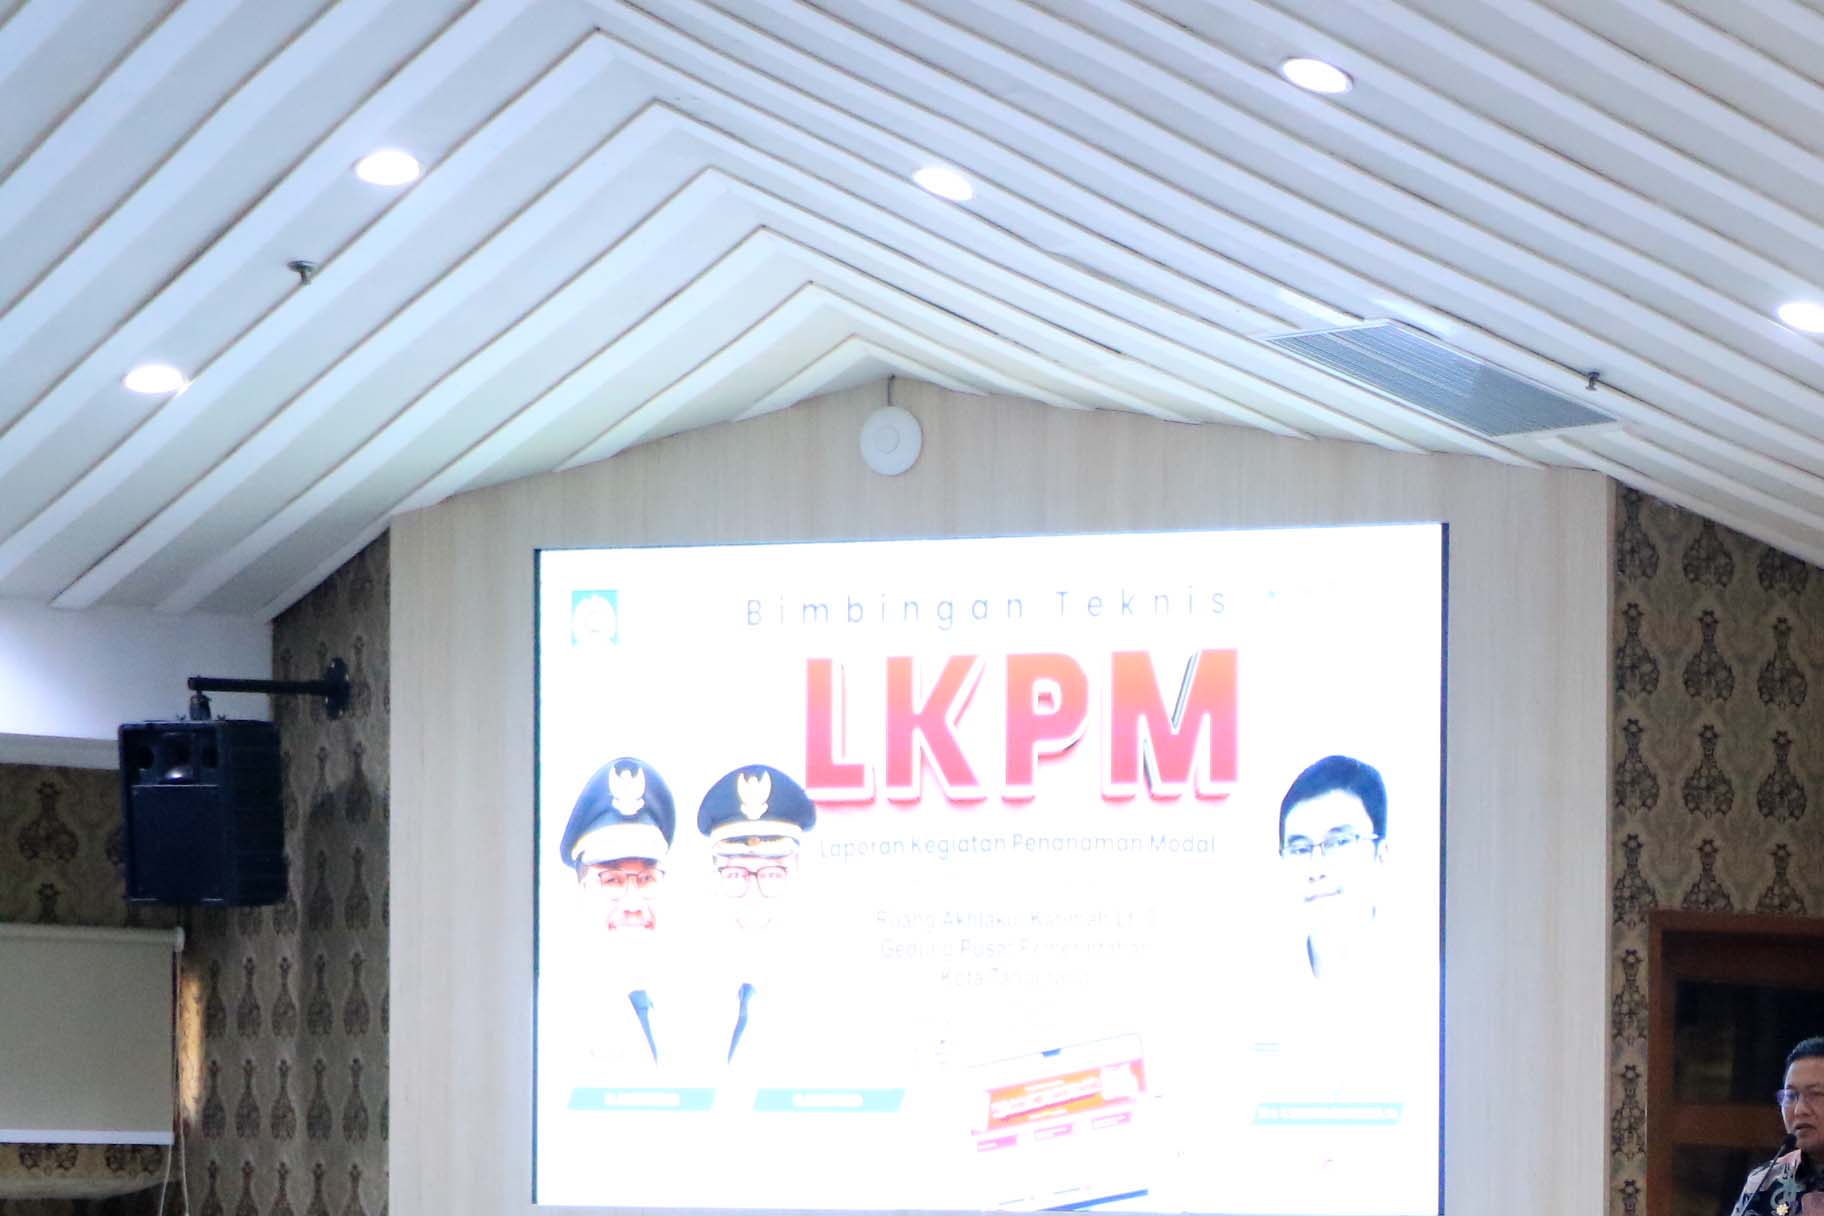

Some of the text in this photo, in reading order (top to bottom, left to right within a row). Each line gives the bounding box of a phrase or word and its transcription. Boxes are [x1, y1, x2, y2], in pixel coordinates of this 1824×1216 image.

[747, 586, 1227, 630] Bimbingan Teknis
[804, 648, 1239, 802] LKPM
[820, 833, 1217, 861] Laporan Kegiatan Penanaman Modal
